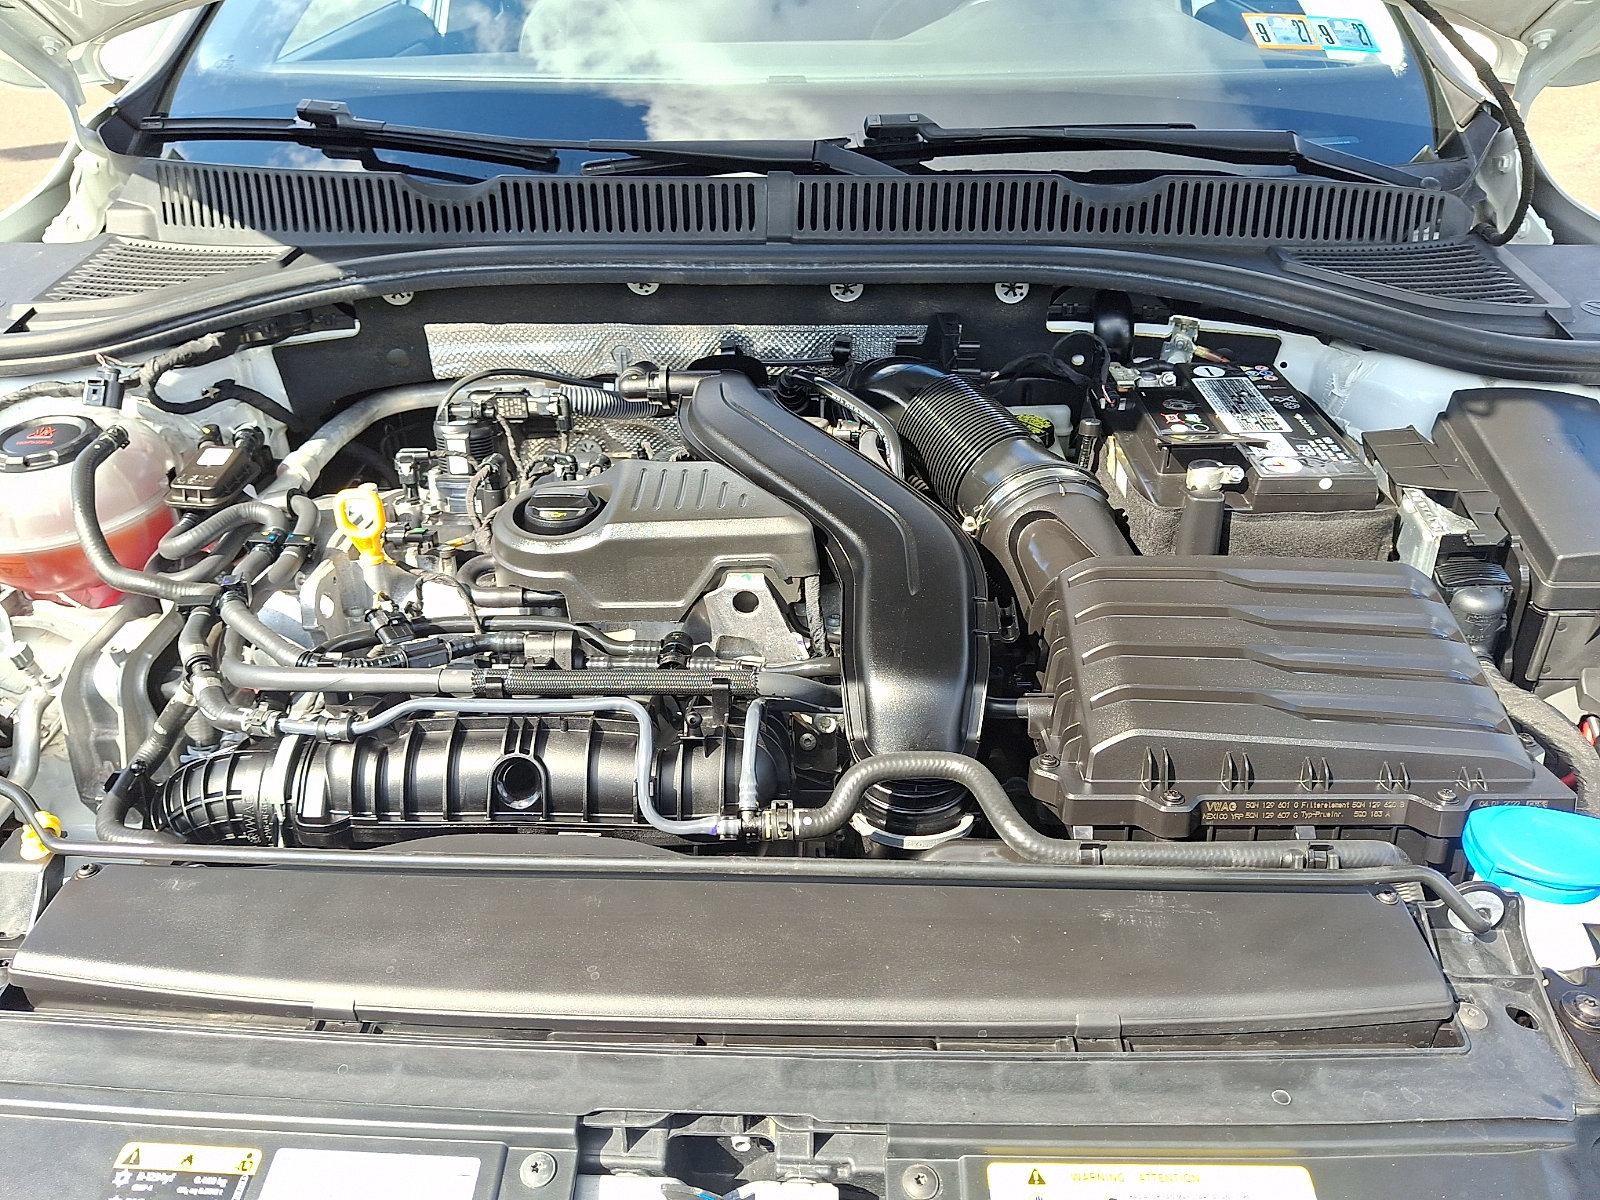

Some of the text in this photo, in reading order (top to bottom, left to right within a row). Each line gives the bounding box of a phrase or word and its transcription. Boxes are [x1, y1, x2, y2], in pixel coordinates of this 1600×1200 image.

[1255, 19, 1313, 43] 9 27
[1318, 22, 1373, 47] 9 27
[1262, 801, 1275, 809] 129
[1277, 801, 1290, 809] 601
[1202, 812, 1228, 821] MEXICO
[1262, 811, 1275, 819] 129
[1276, 811, 1291, 819] 607
[1070, 1172, 1200, 1184] WARNING ATTENTION
